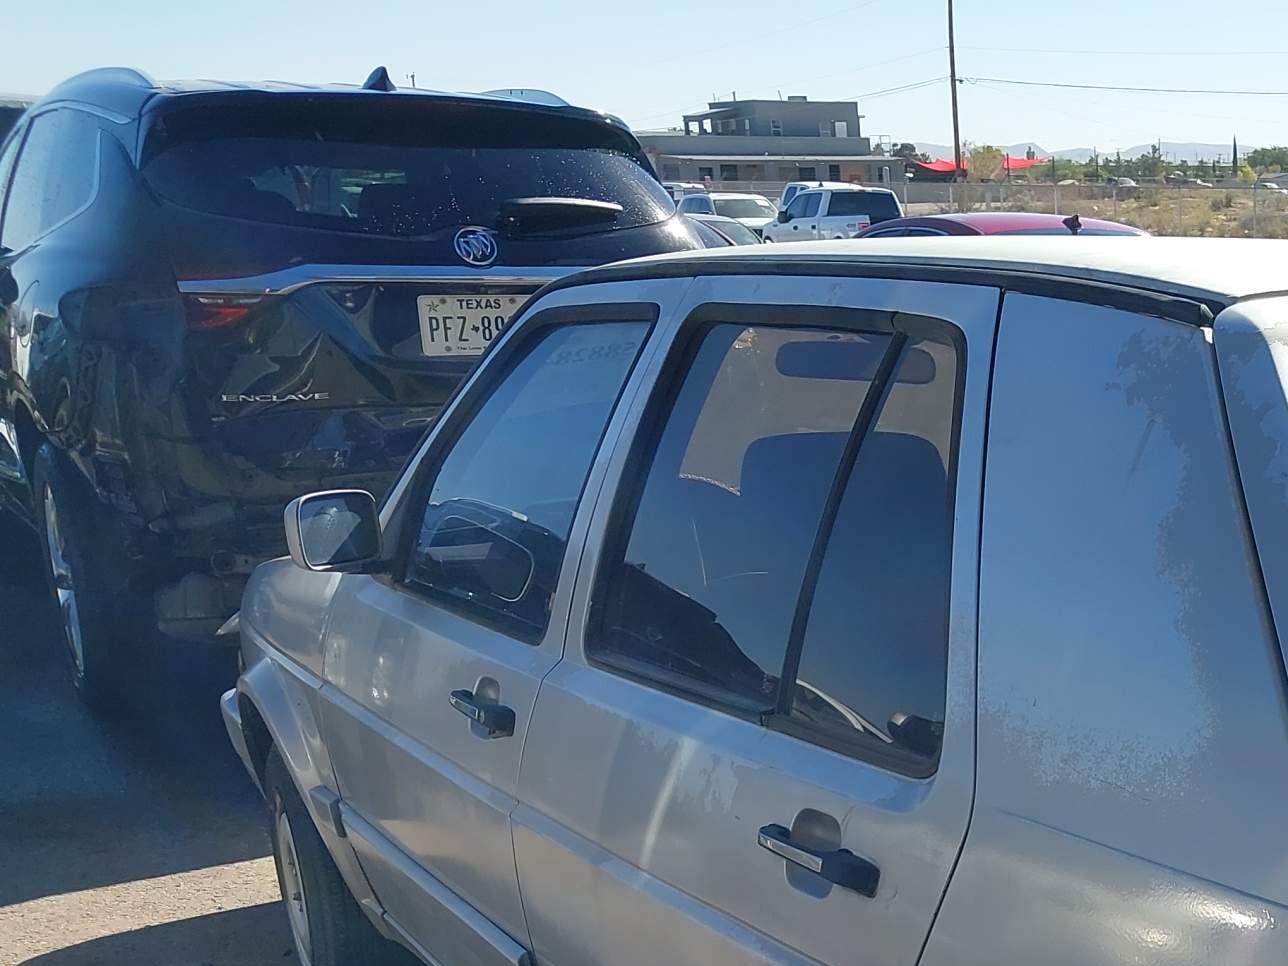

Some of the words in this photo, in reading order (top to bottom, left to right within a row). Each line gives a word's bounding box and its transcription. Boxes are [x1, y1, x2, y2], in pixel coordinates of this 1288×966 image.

[456, 299, 501, 310] TEXAS
[428, 316, 469, 342] PFZ
[481, 315, 513, 341] 89
[221, 392, 329, 402] ENCLAVE
